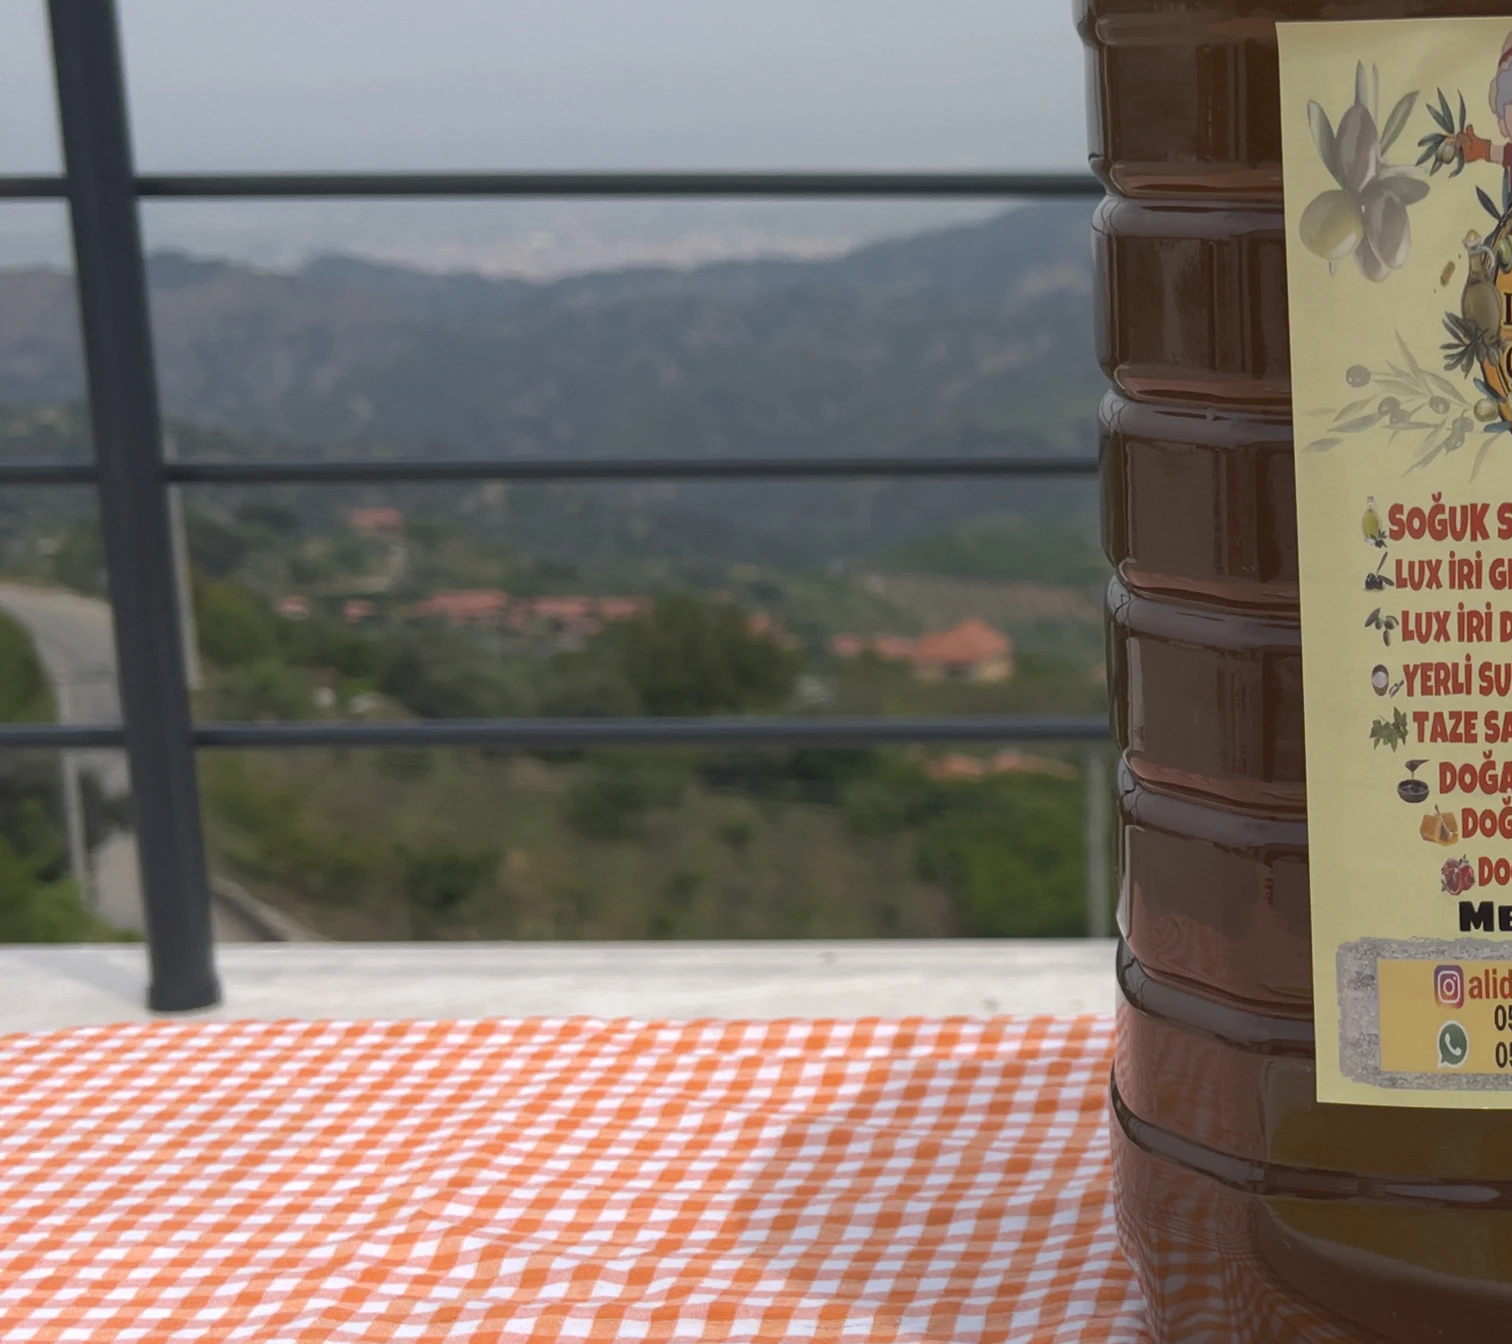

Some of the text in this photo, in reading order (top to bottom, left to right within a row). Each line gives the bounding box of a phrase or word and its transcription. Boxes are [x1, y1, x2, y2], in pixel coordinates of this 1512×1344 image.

[1388, 492, 1491, 541] SOĞUK
[1395, 559, 1442, 591] LUX
[1449, 551, 1482, 590] İRİ
[1401, 611, 1451, 644] LUX
[1457, 602, 1492, 643] İRİ
[1403, 654, 1472, 698] YERLİ
[1412, 711, 1478, 743] TAZE
